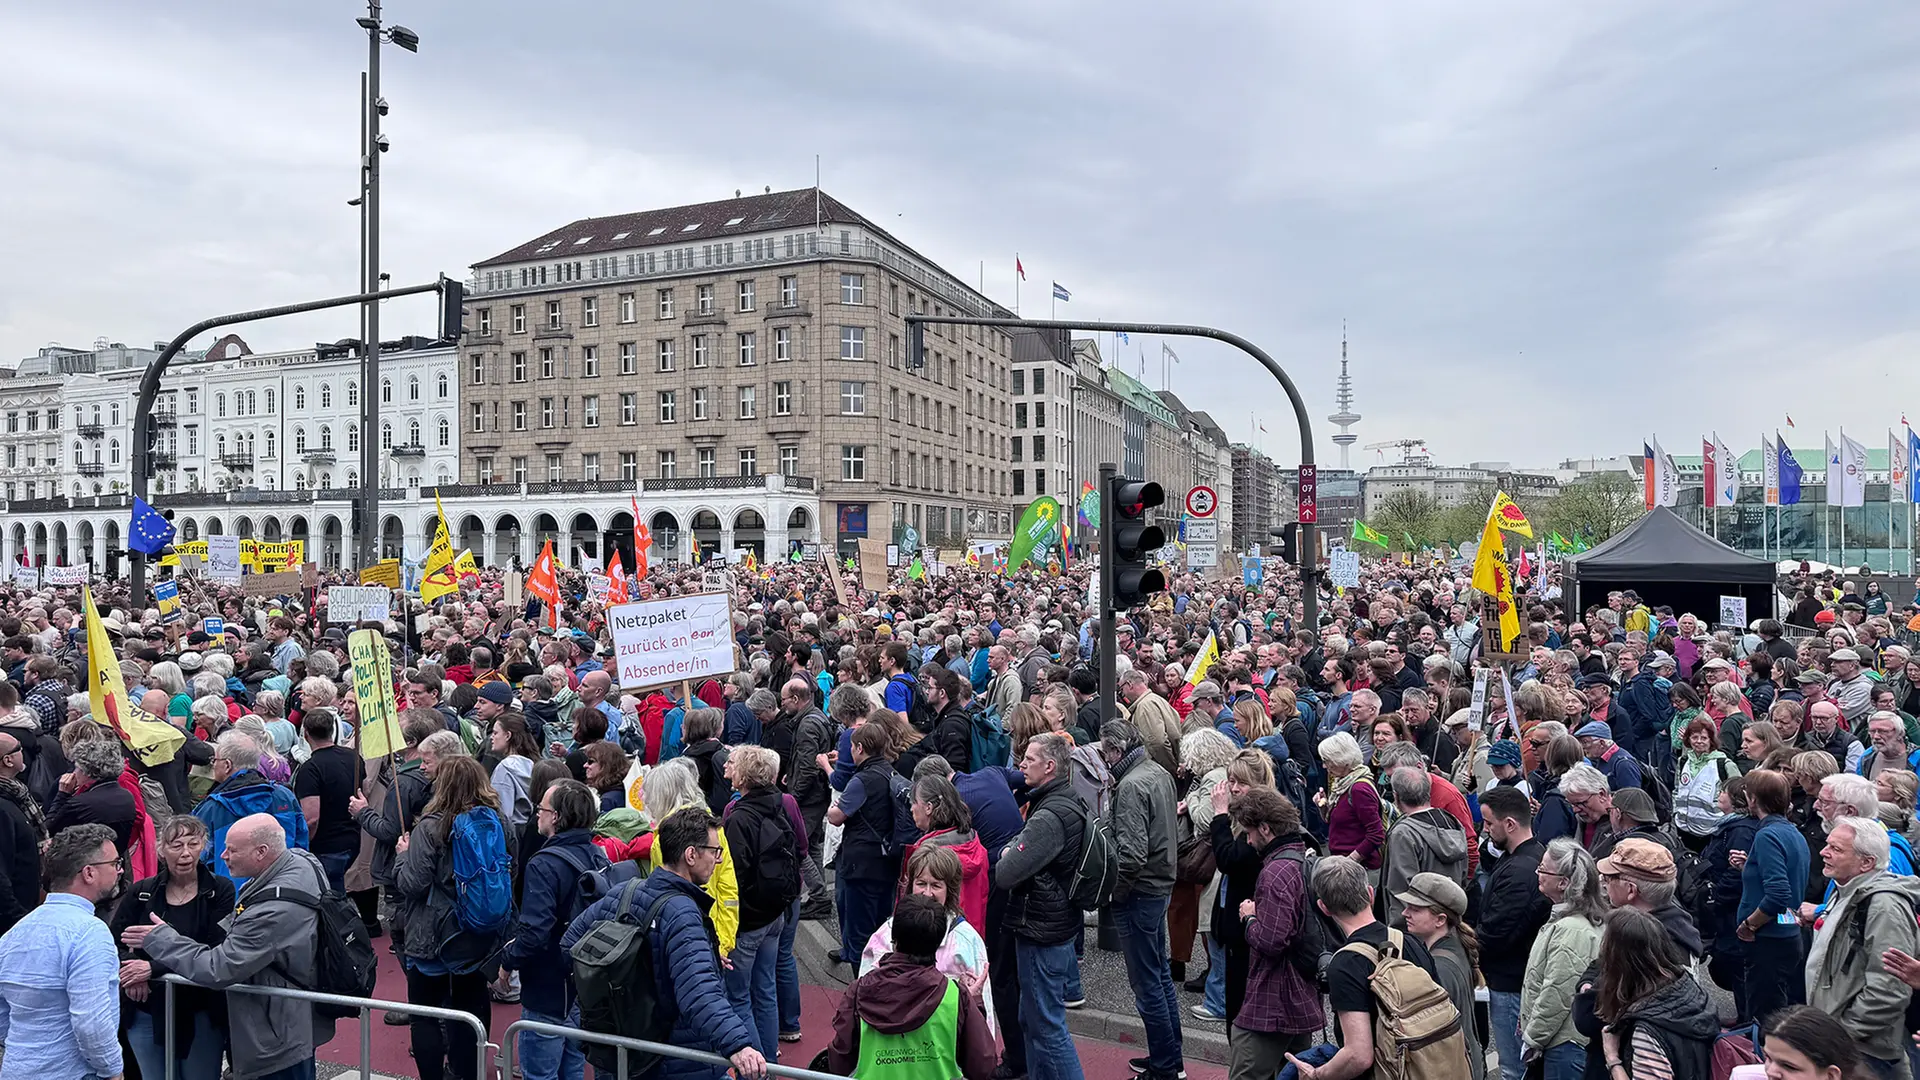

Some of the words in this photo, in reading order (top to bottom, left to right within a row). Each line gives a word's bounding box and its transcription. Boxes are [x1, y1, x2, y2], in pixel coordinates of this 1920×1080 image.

[1302, 468, 1313, 476] 03
[1496, 513, 1509, 527] NEIN
[1336, 552, 1355, 561] ICH
[1336, 561, 1354, 570] BIN
[331, 604, 357, 620] GEGEN
[616, 608, 687, 629] Netzpaket
[621, 636, 667, 655] zurück
[671, 636, 687, 647] an
[624, 656, 709, 680] Absender/in
[358, 681, 374, 700] NOT
[875, 1047, 921, 1057] GEMEINWOHL
[875, 1056, 915, 1066] ÖKONOMIE
